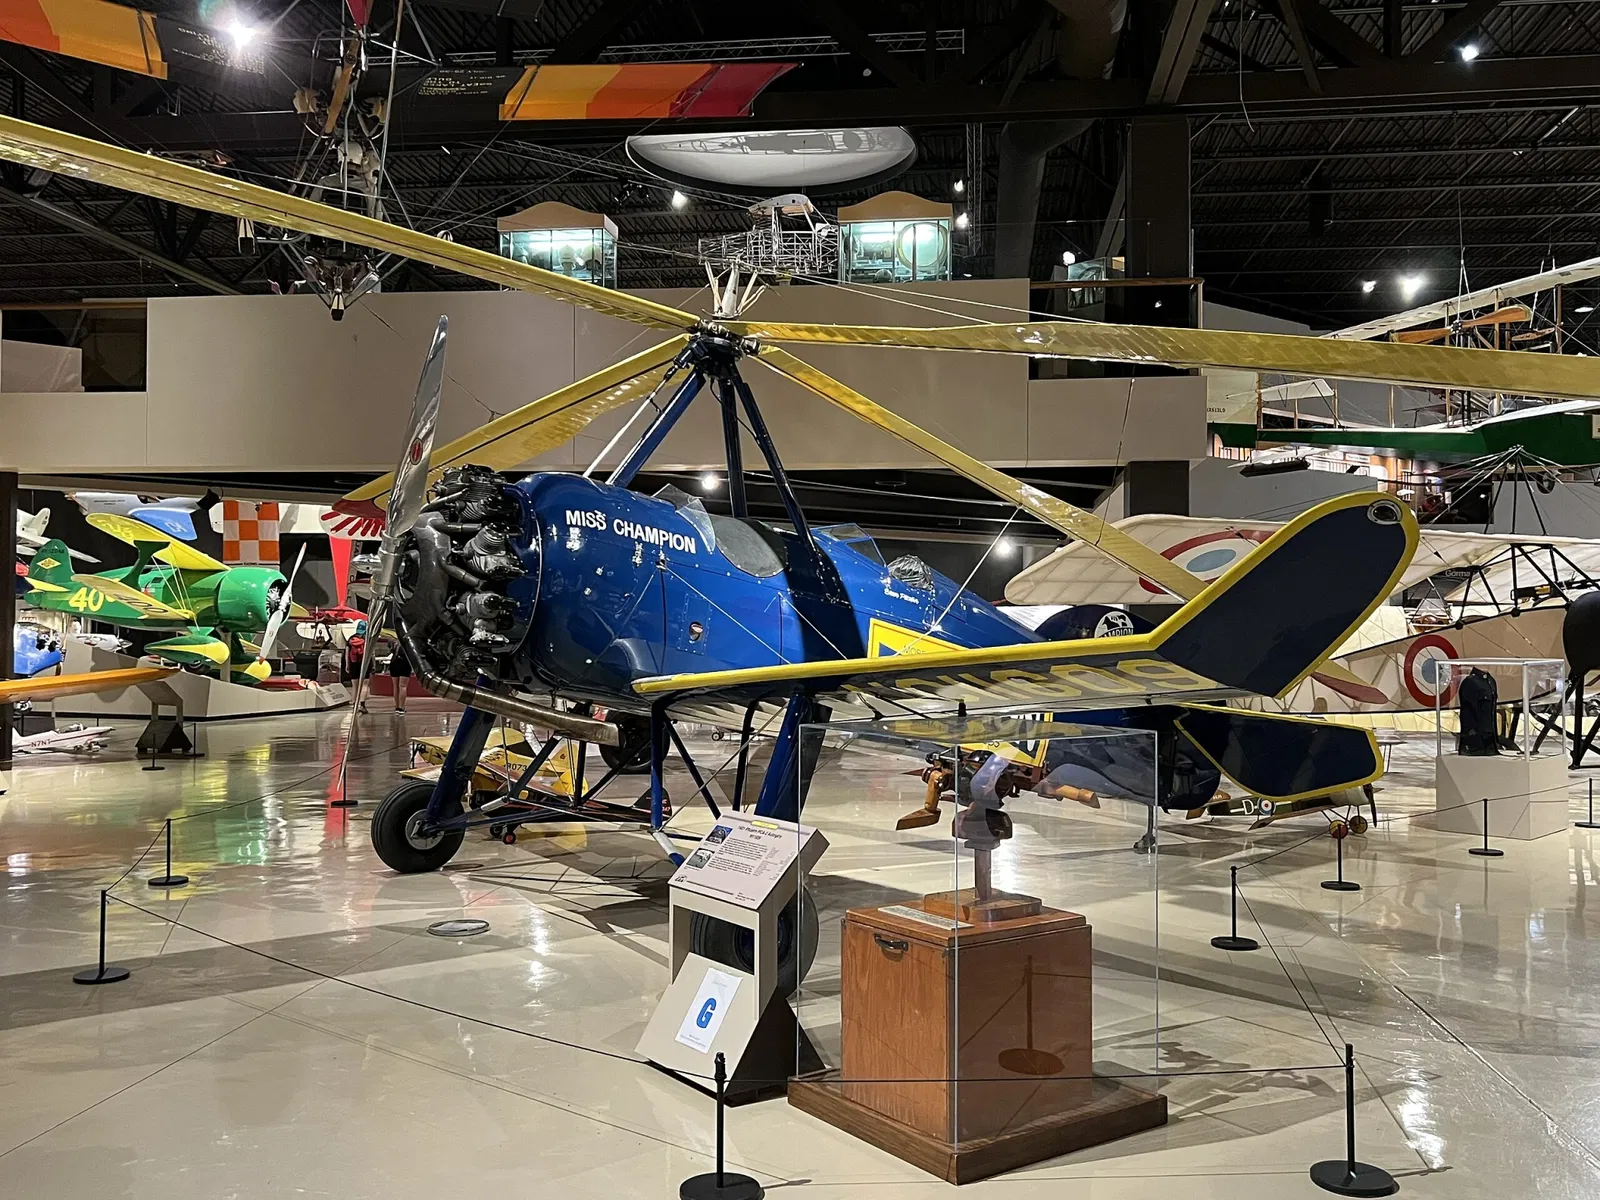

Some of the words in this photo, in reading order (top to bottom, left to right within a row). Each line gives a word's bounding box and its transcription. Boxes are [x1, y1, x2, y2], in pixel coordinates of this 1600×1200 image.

[565, 509, 607, 531] MISS
[613, 518, 697, 554] CHAMPION
[696, 997, 717, 1029] G
